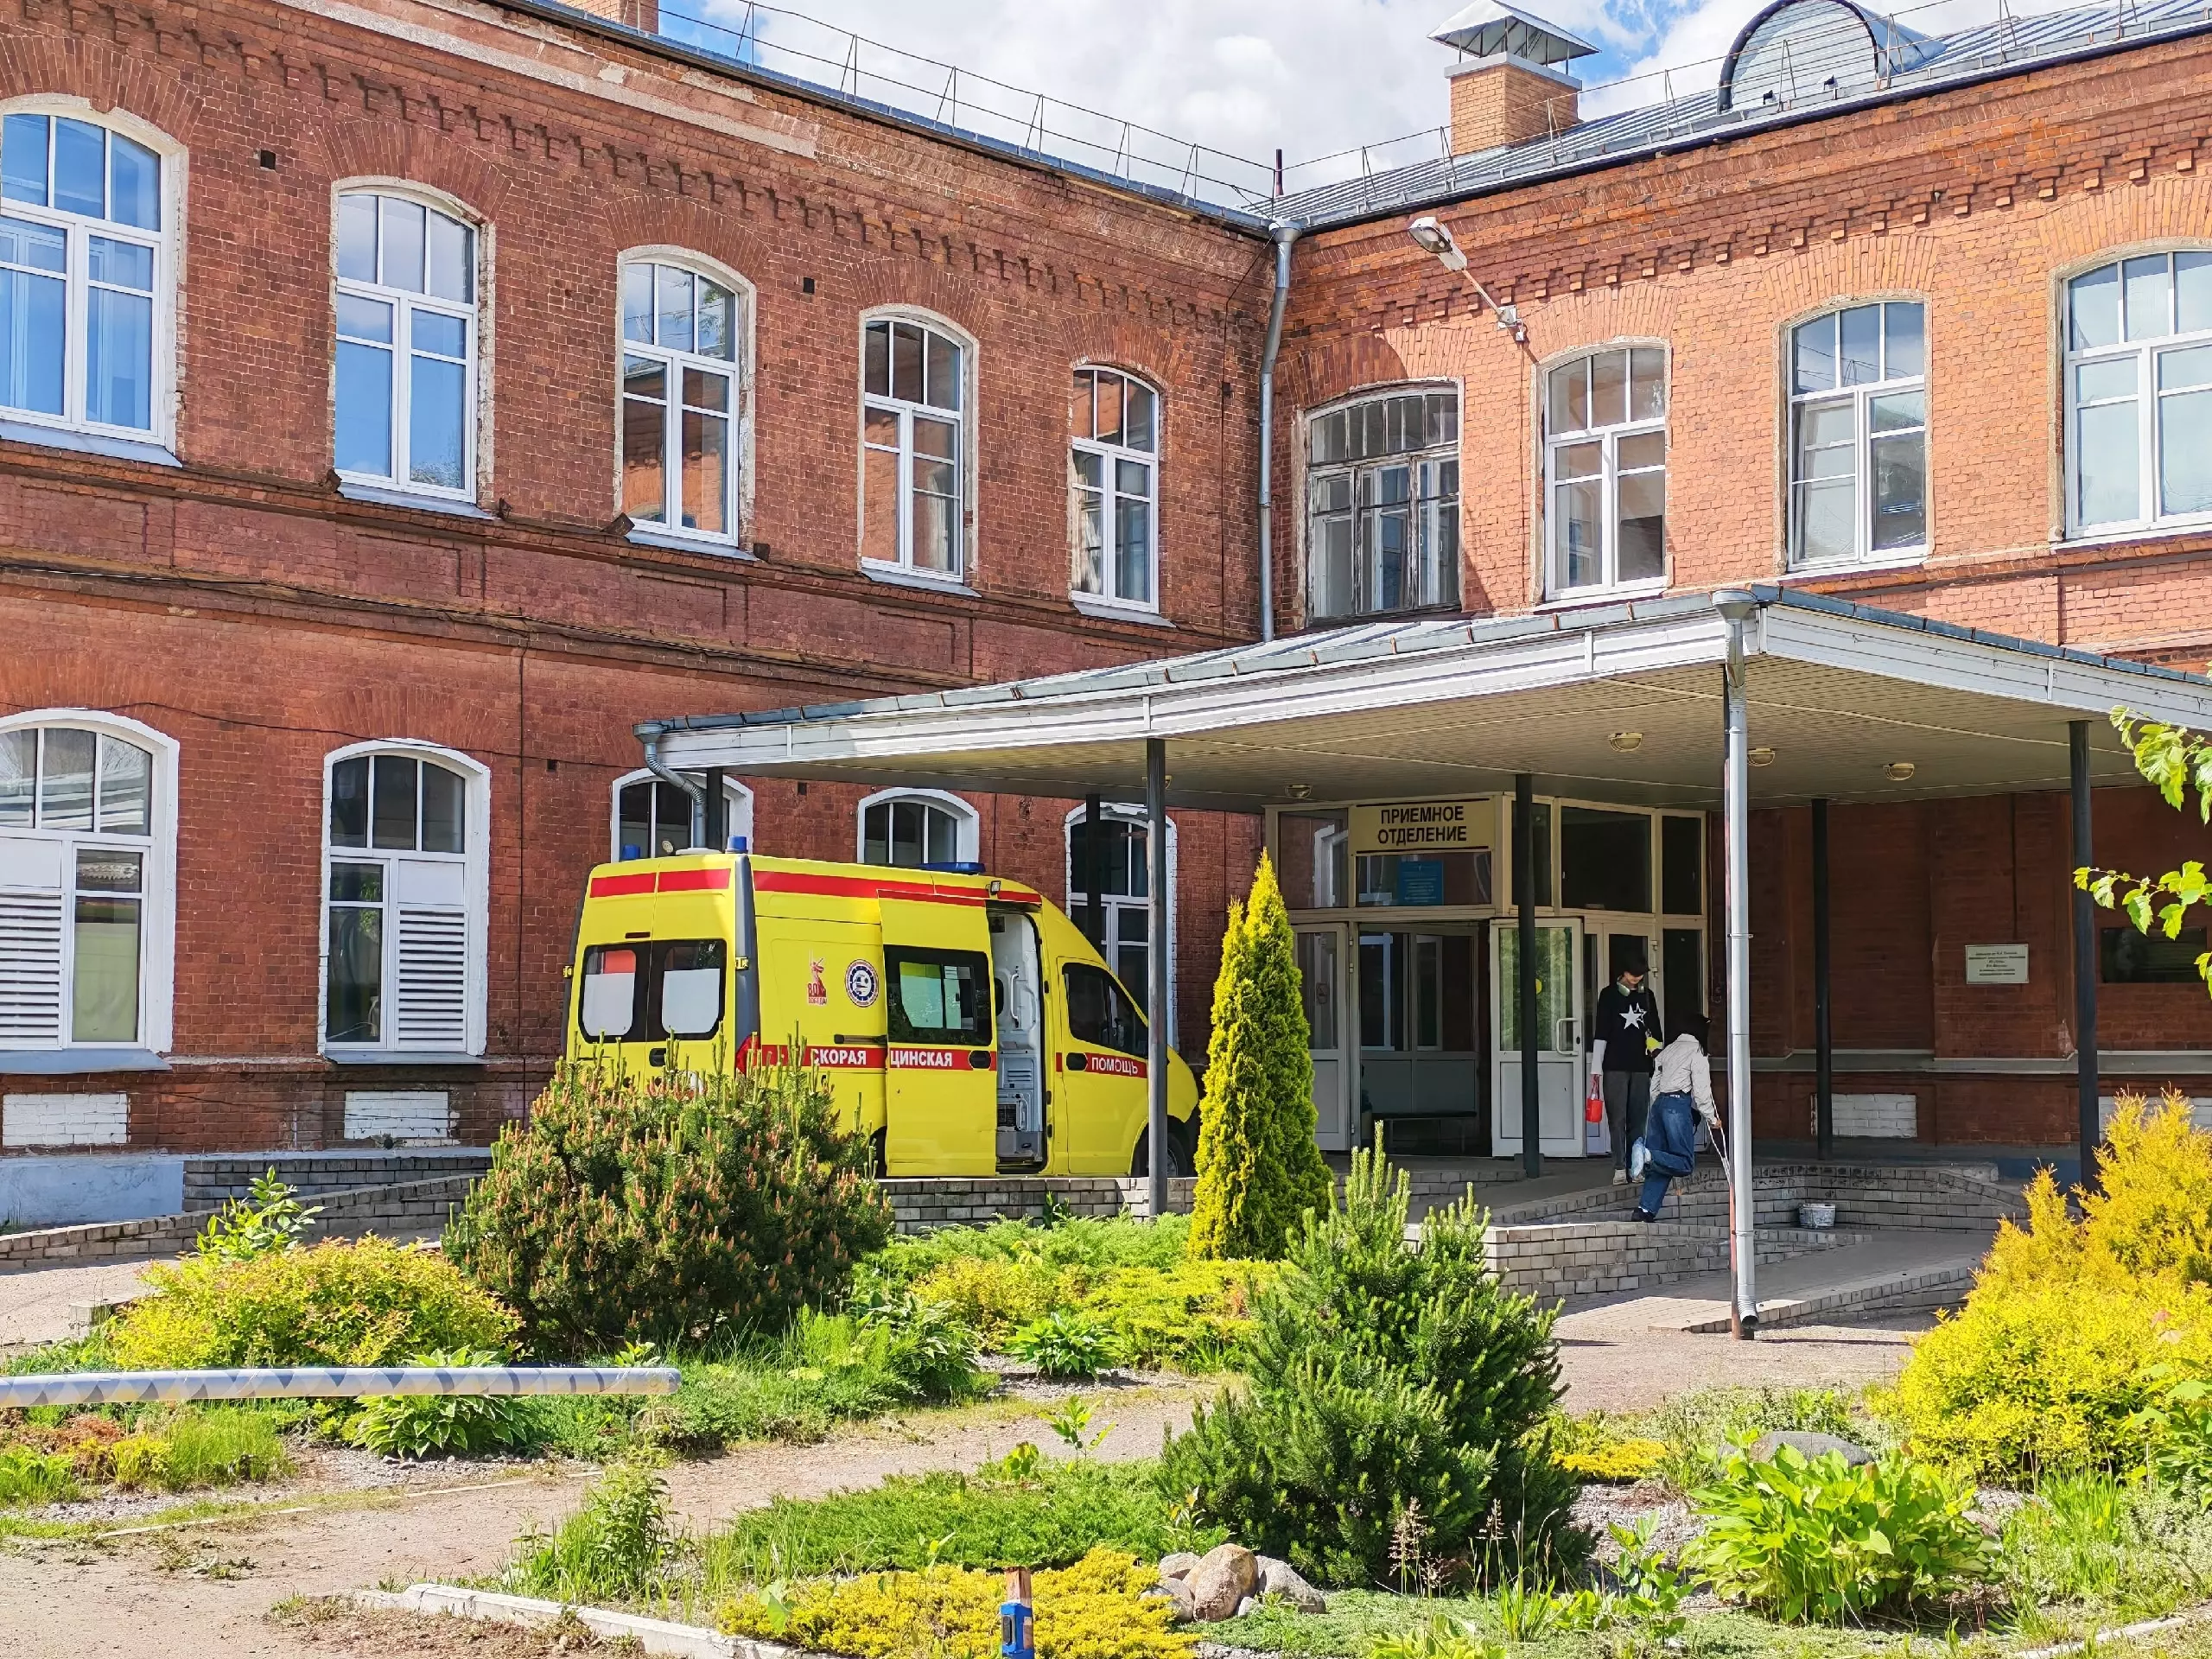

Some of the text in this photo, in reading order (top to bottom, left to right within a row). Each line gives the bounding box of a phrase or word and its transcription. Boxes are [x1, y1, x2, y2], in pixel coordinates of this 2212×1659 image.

[1381, 805, 1464, 824] ПРИЕМНОЕ
[1377, 825, 1467, 846] ОТДЕЛЕНИЕ
[1091, 1057, 1139, 1076] ПОМОЩЬ
